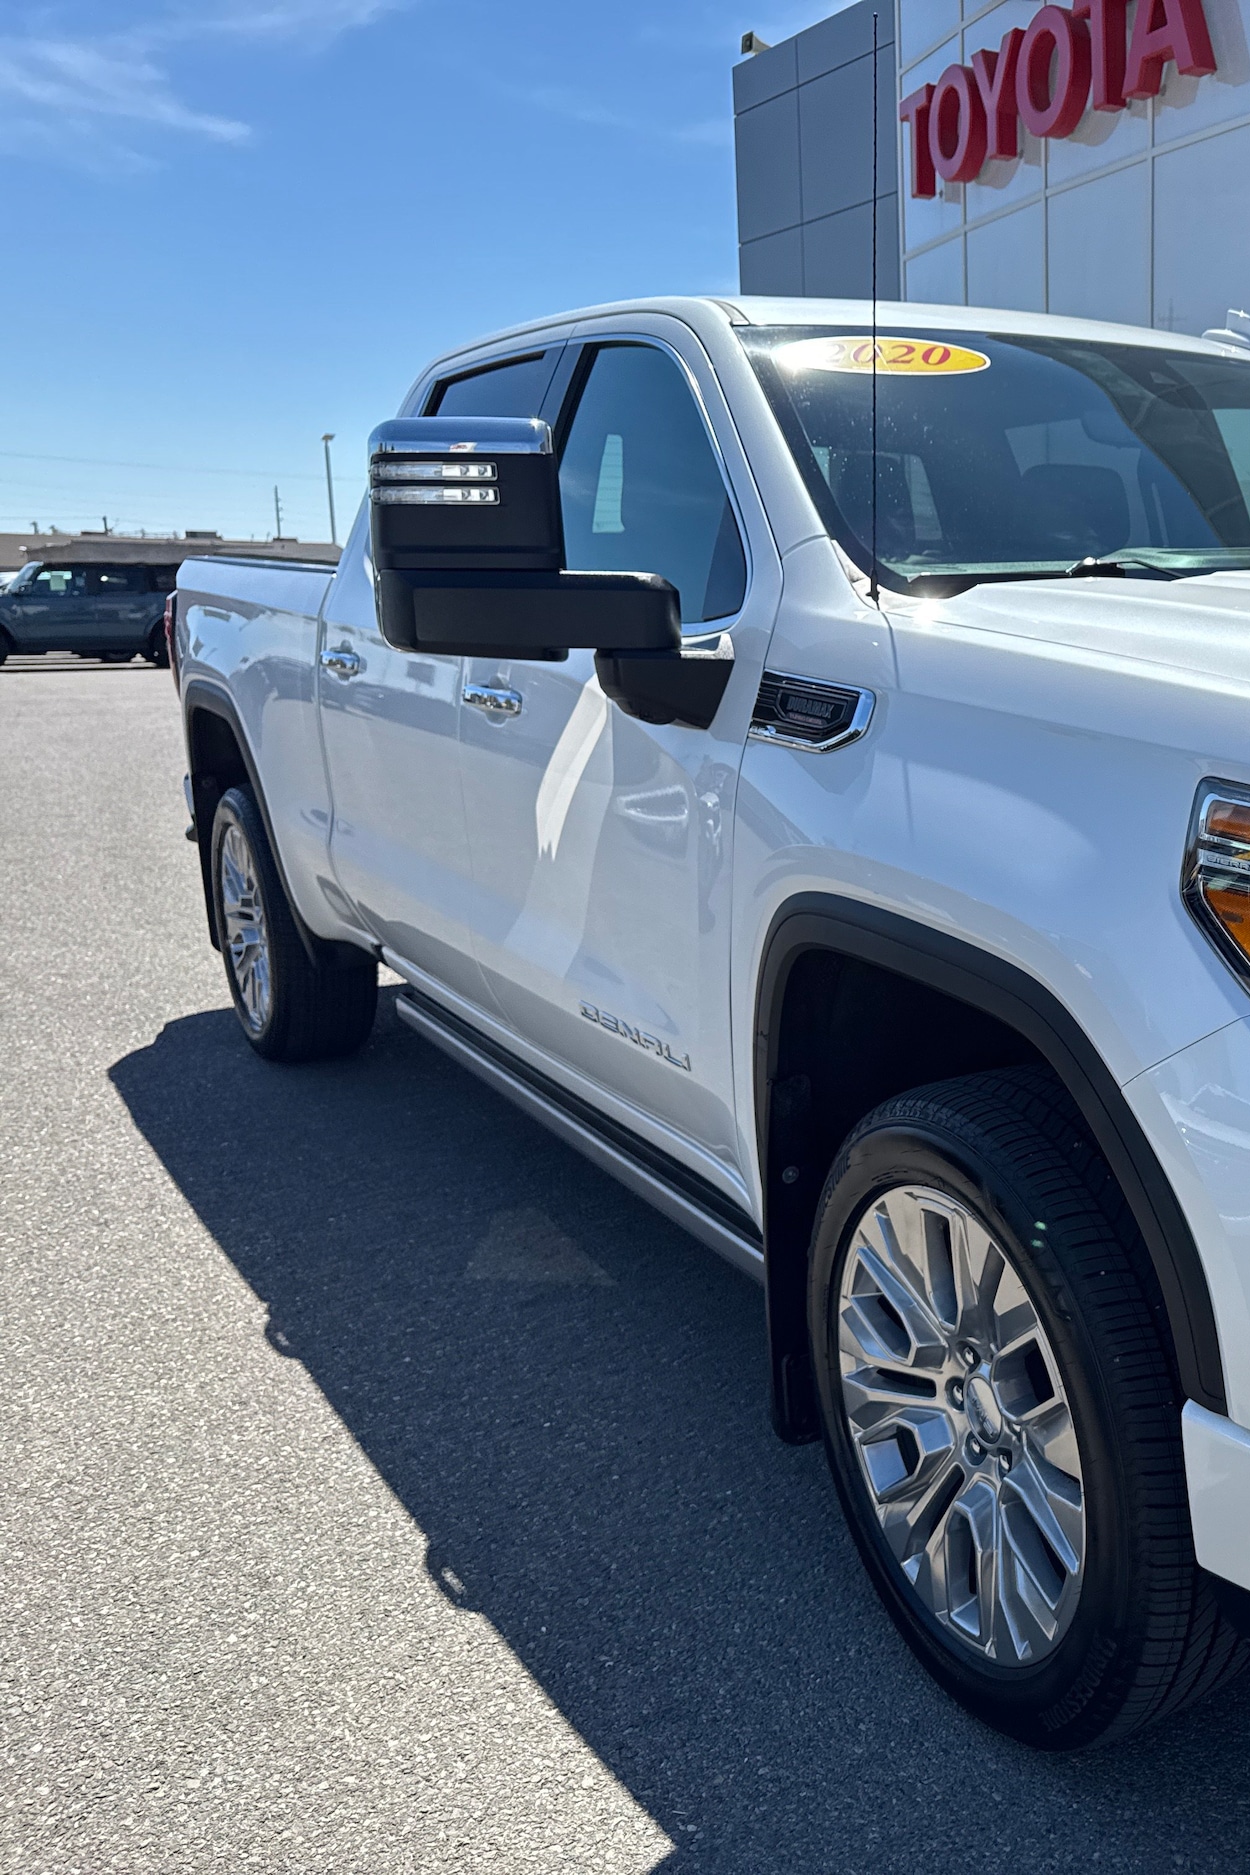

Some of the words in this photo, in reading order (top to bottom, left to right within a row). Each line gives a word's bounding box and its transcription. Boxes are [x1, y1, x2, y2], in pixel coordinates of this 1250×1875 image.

[900, 0, 1217, 198] TOYOTA
[825, 341, 952, 367] 2020
[579, 999, 692, 1072] DENALI
